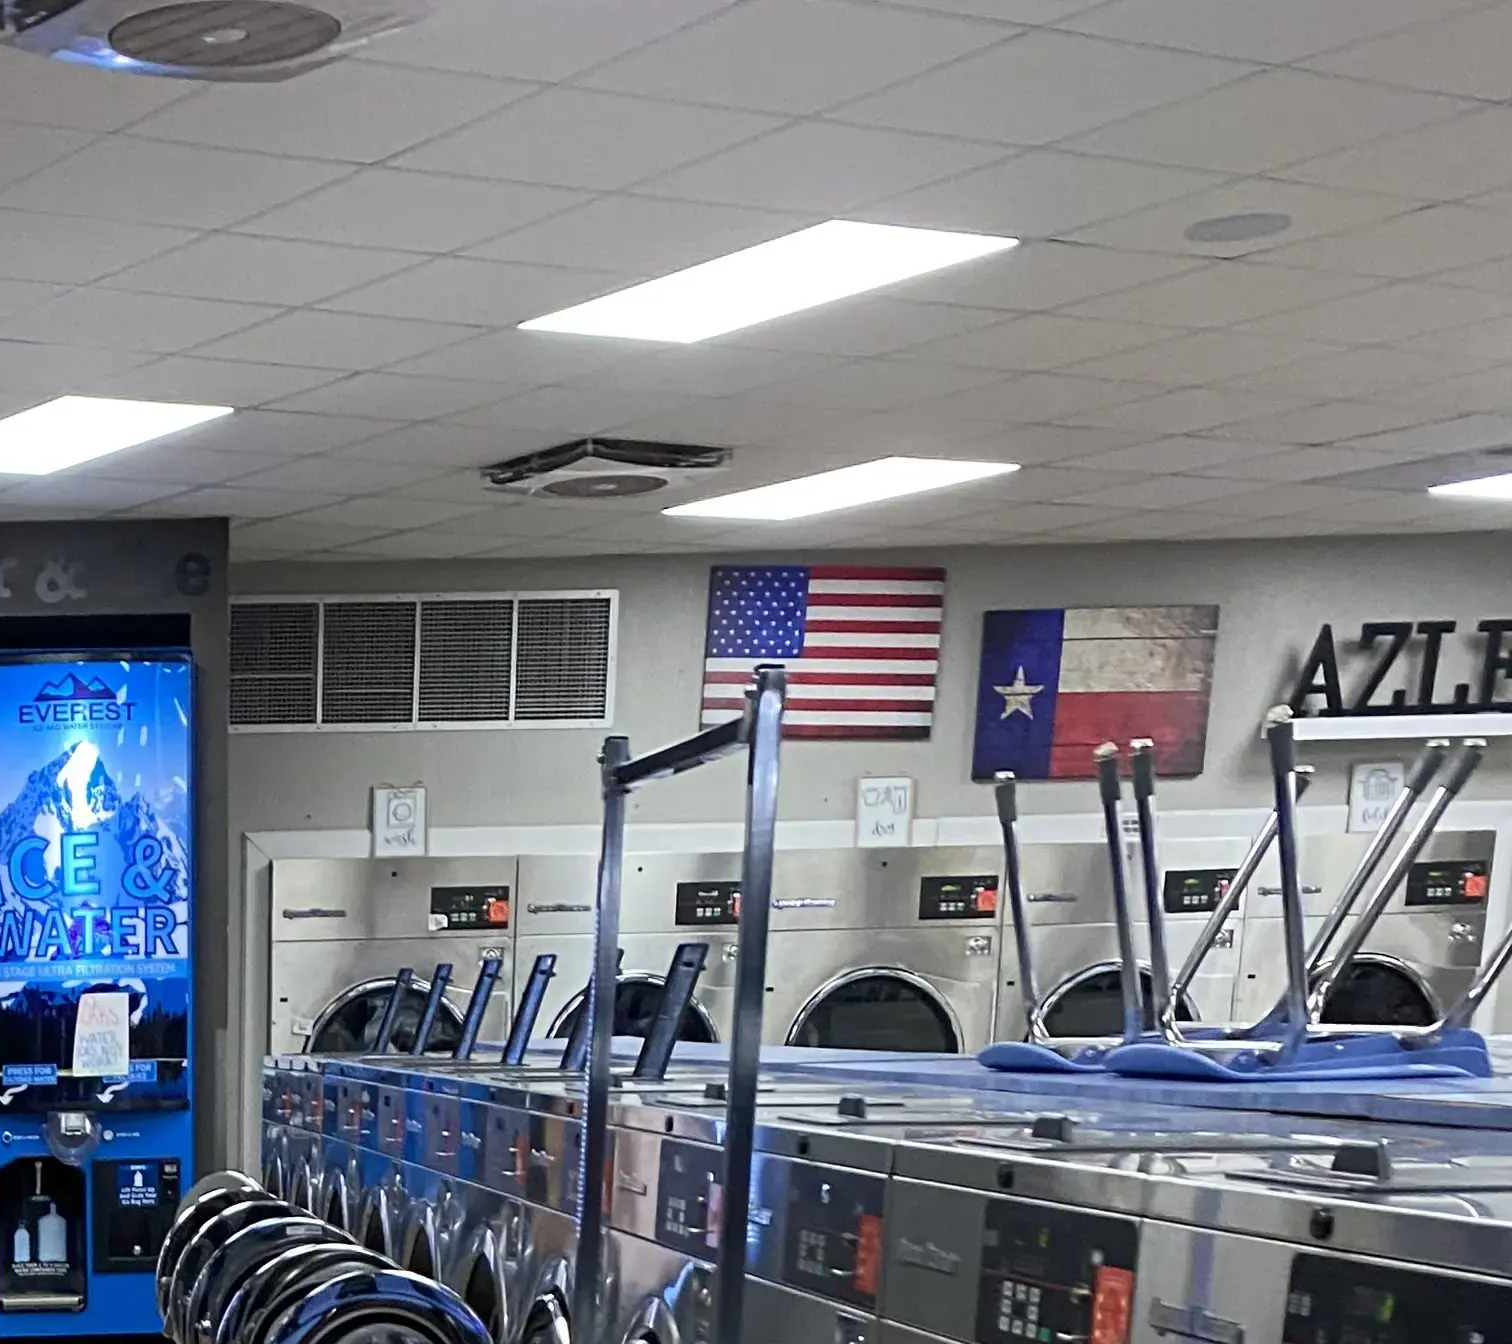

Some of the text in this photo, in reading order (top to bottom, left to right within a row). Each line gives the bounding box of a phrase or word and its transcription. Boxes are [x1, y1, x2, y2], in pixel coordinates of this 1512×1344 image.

[18, 702, 137, 723] EVEREST
[121, 834, 177, 905] &
[3, 966, 35, 978] STAGE
[38, 965, 73, 977] ULTRA
[75, 964, 134, 977] FILTRATION
[137, 962, 176, 974] SYSTEM
